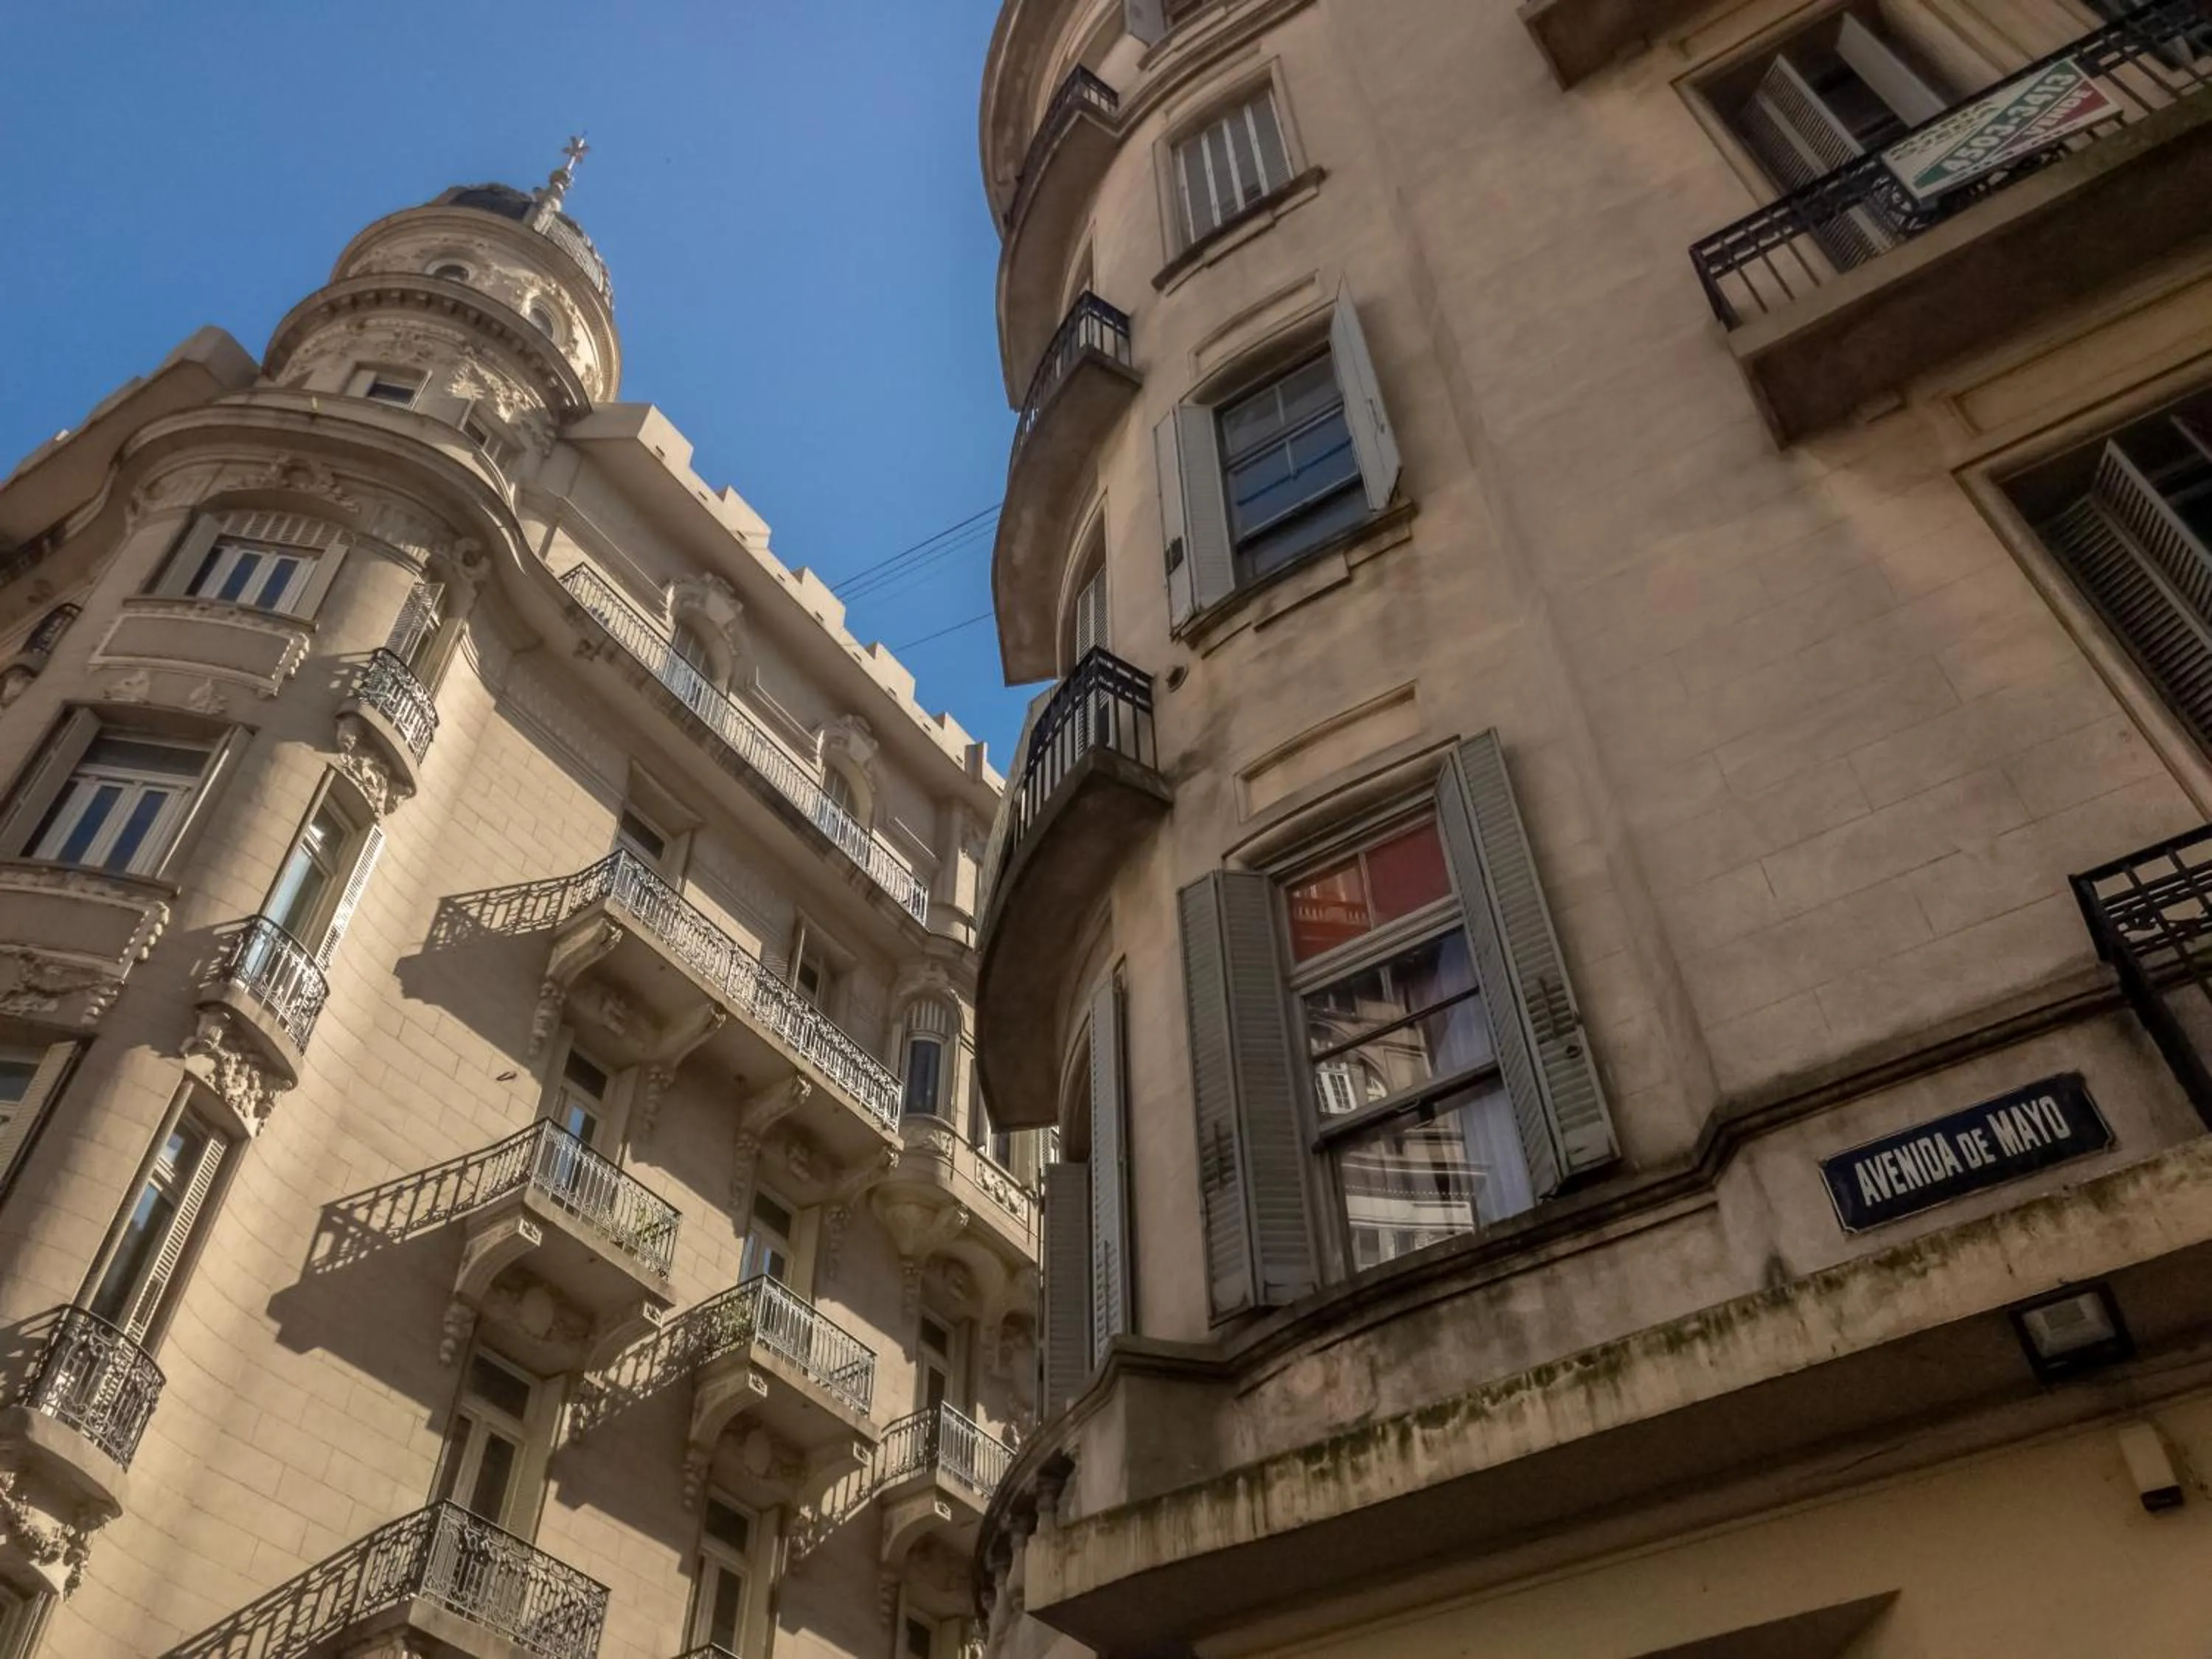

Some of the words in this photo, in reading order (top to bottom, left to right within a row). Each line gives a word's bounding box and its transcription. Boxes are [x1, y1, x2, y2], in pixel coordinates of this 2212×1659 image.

[1854, 1133, 1964, 1206] AVENIDA
[1957, 1127, 1996, 1169] DE
[1986, 1096, 2071, 1157] MAYO
